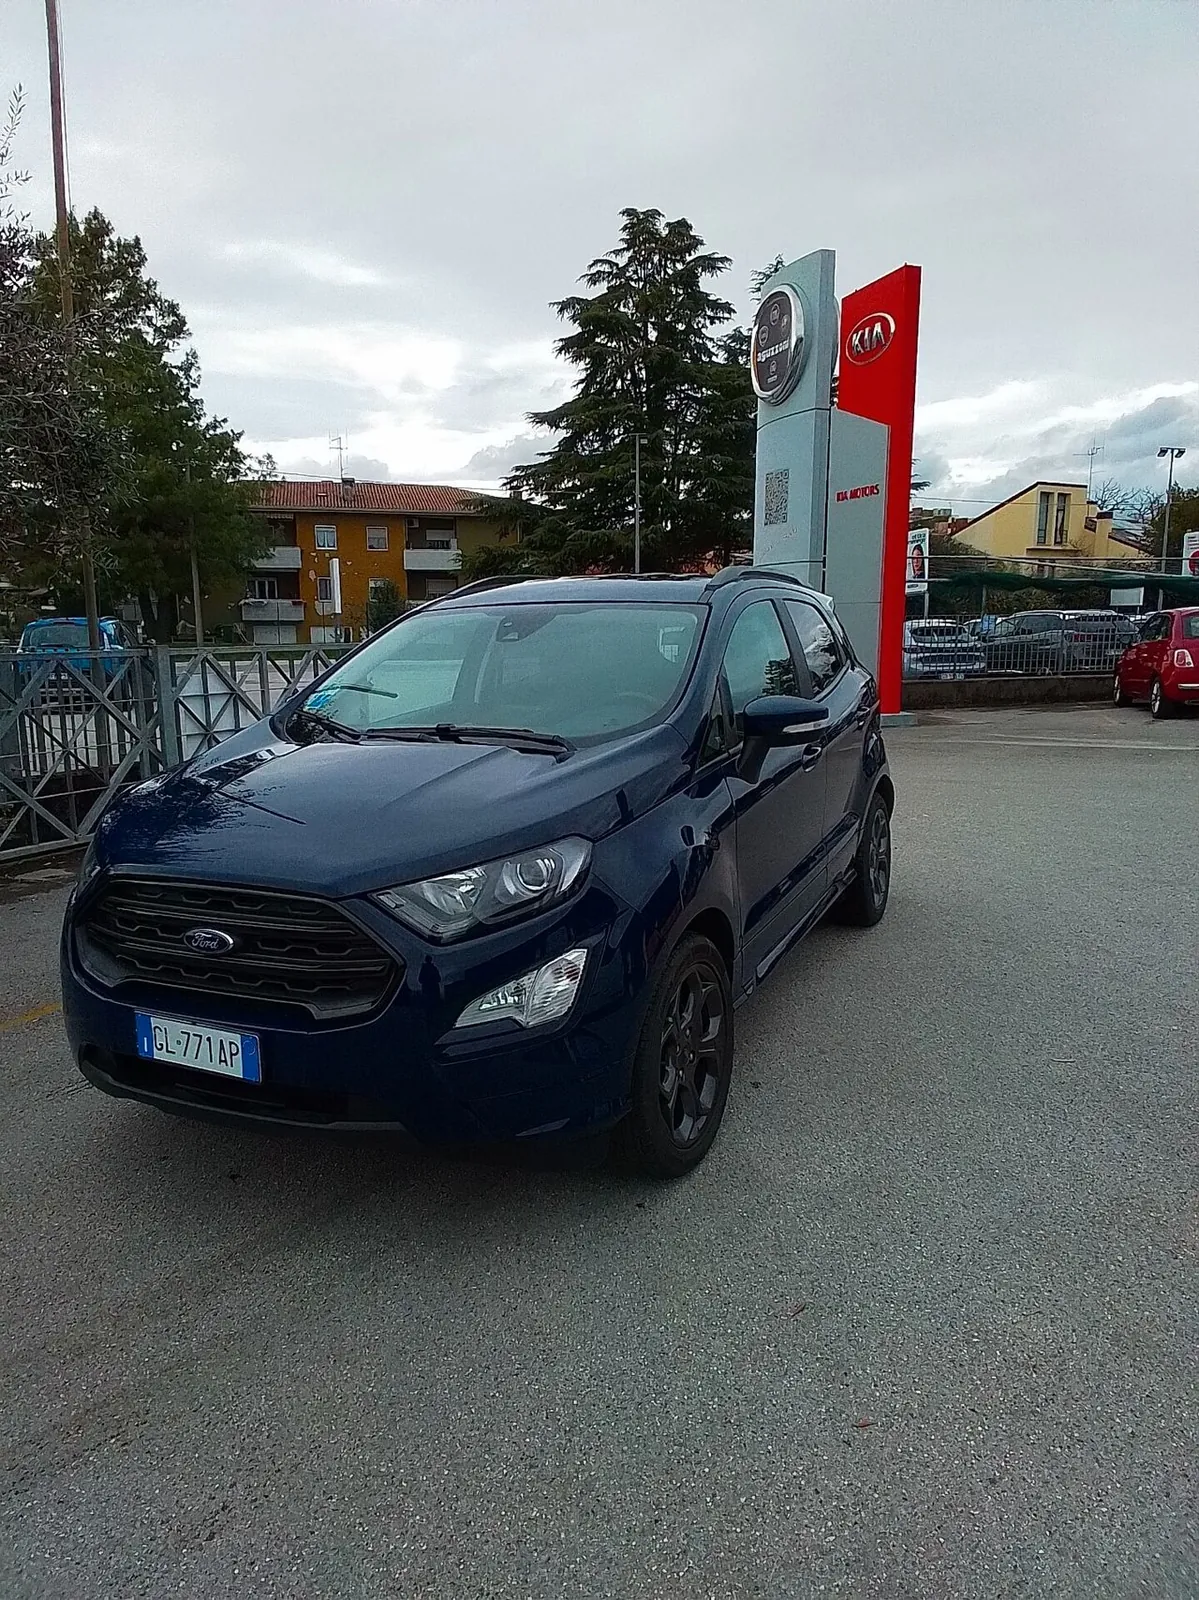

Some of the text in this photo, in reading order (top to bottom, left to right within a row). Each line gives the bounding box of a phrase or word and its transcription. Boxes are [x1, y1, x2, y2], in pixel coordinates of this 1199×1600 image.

[851, 321, 885, 356] KIA
[849, 483, 880, 499] MOTORS
[191, 932, 219, 949] Ford
